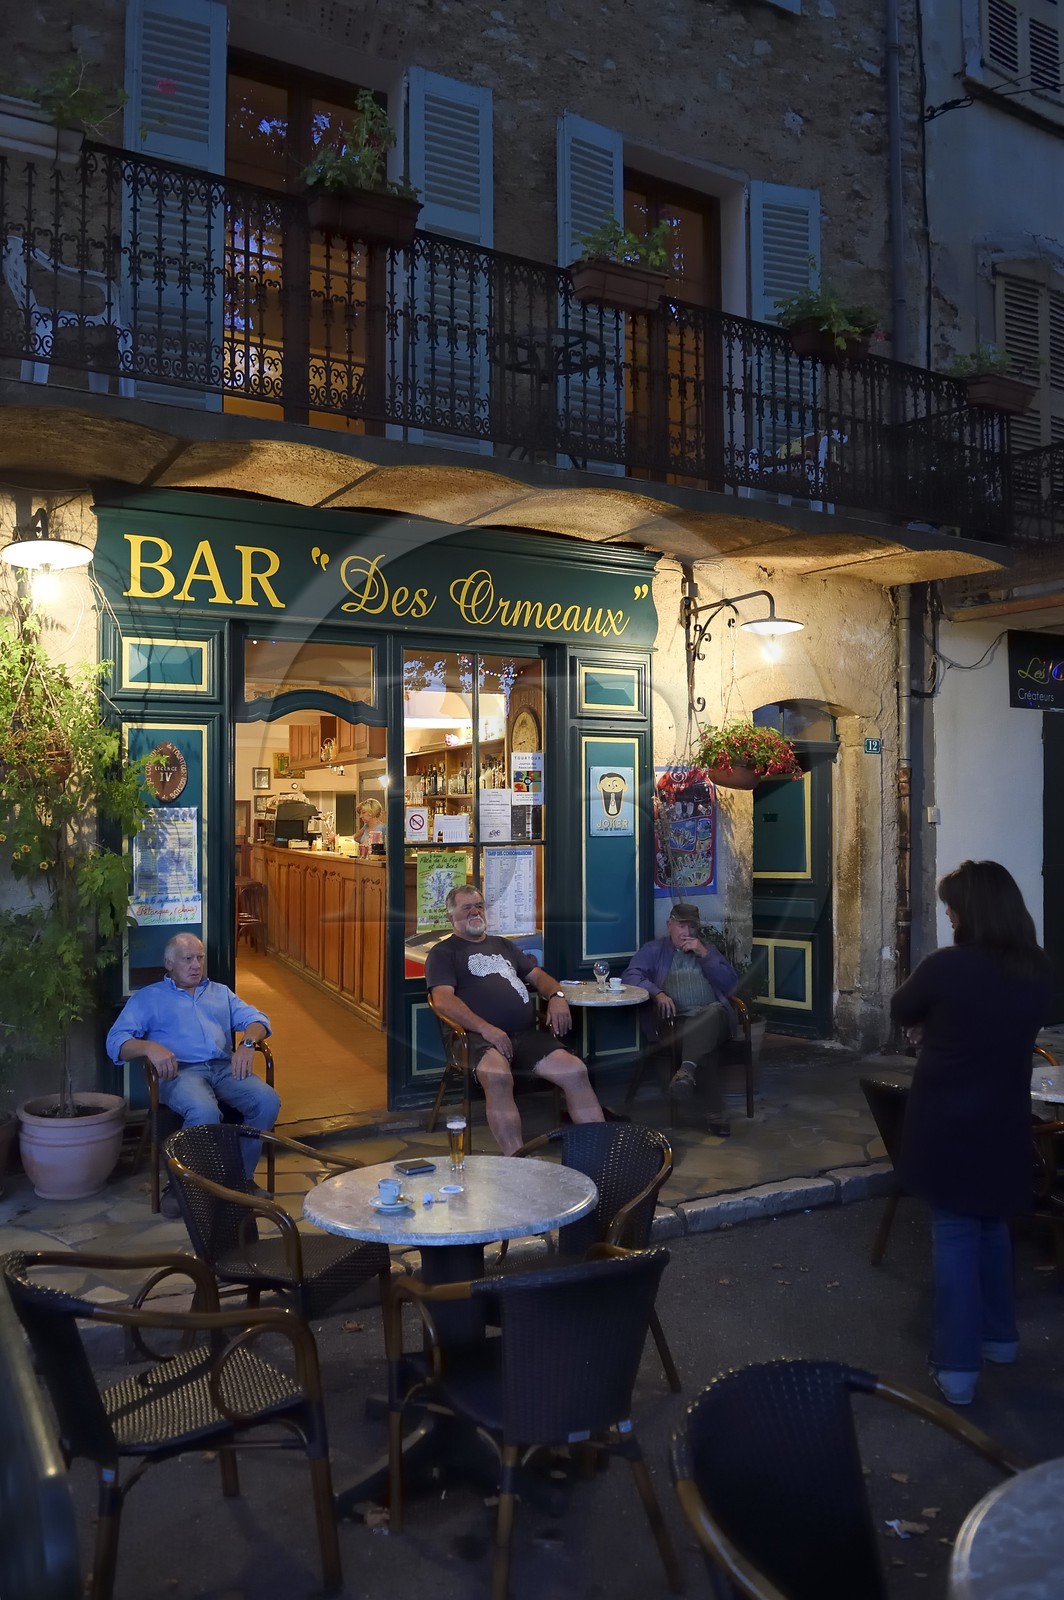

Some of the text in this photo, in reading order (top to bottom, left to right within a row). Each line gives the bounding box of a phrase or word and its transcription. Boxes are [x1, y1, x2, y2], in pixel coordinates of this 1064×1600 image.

[122, 533, 286, 609] BAR
[1018, 688, 1054, 702] Créateurs
[868, 740, 878, 751] 12
[159, 771, 172, 782] IV
[596, 818, 629, 828] JOKER
